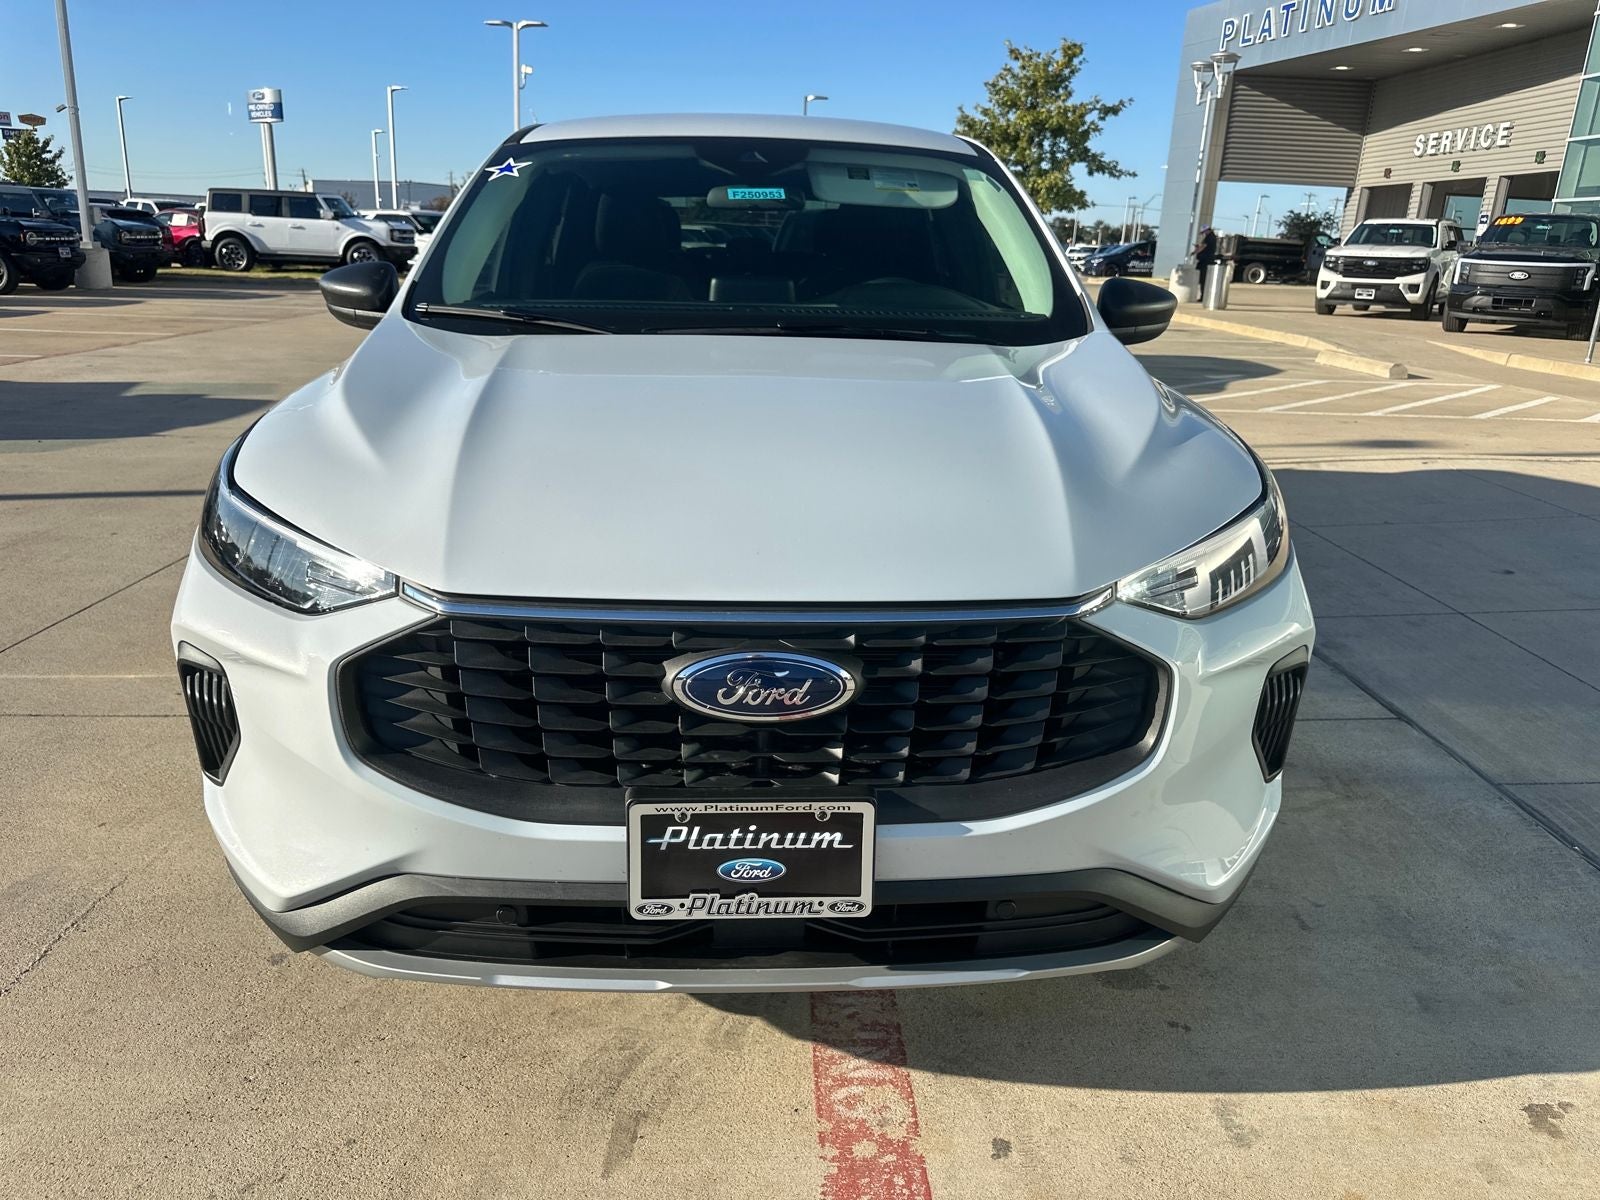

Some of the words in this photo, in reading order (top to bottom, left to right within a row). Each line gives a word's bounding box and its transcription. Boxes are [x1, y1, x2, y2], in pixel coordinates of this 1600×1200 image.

[1413, 121, 1515, 157] SERVICE
[732, 191, 783, 199] F250953
[716, 668, 813, 706] Ford
[654, 803, 851, 813] www.PlatinumFord.com
[646, 824, 854, 851] Platinum
[730, 861, 772, 879] Ford
[642, 903, 668, 915] Ford
[678, 892, 825, 917] Platinum
[833, 901, 859, 913] Ford
